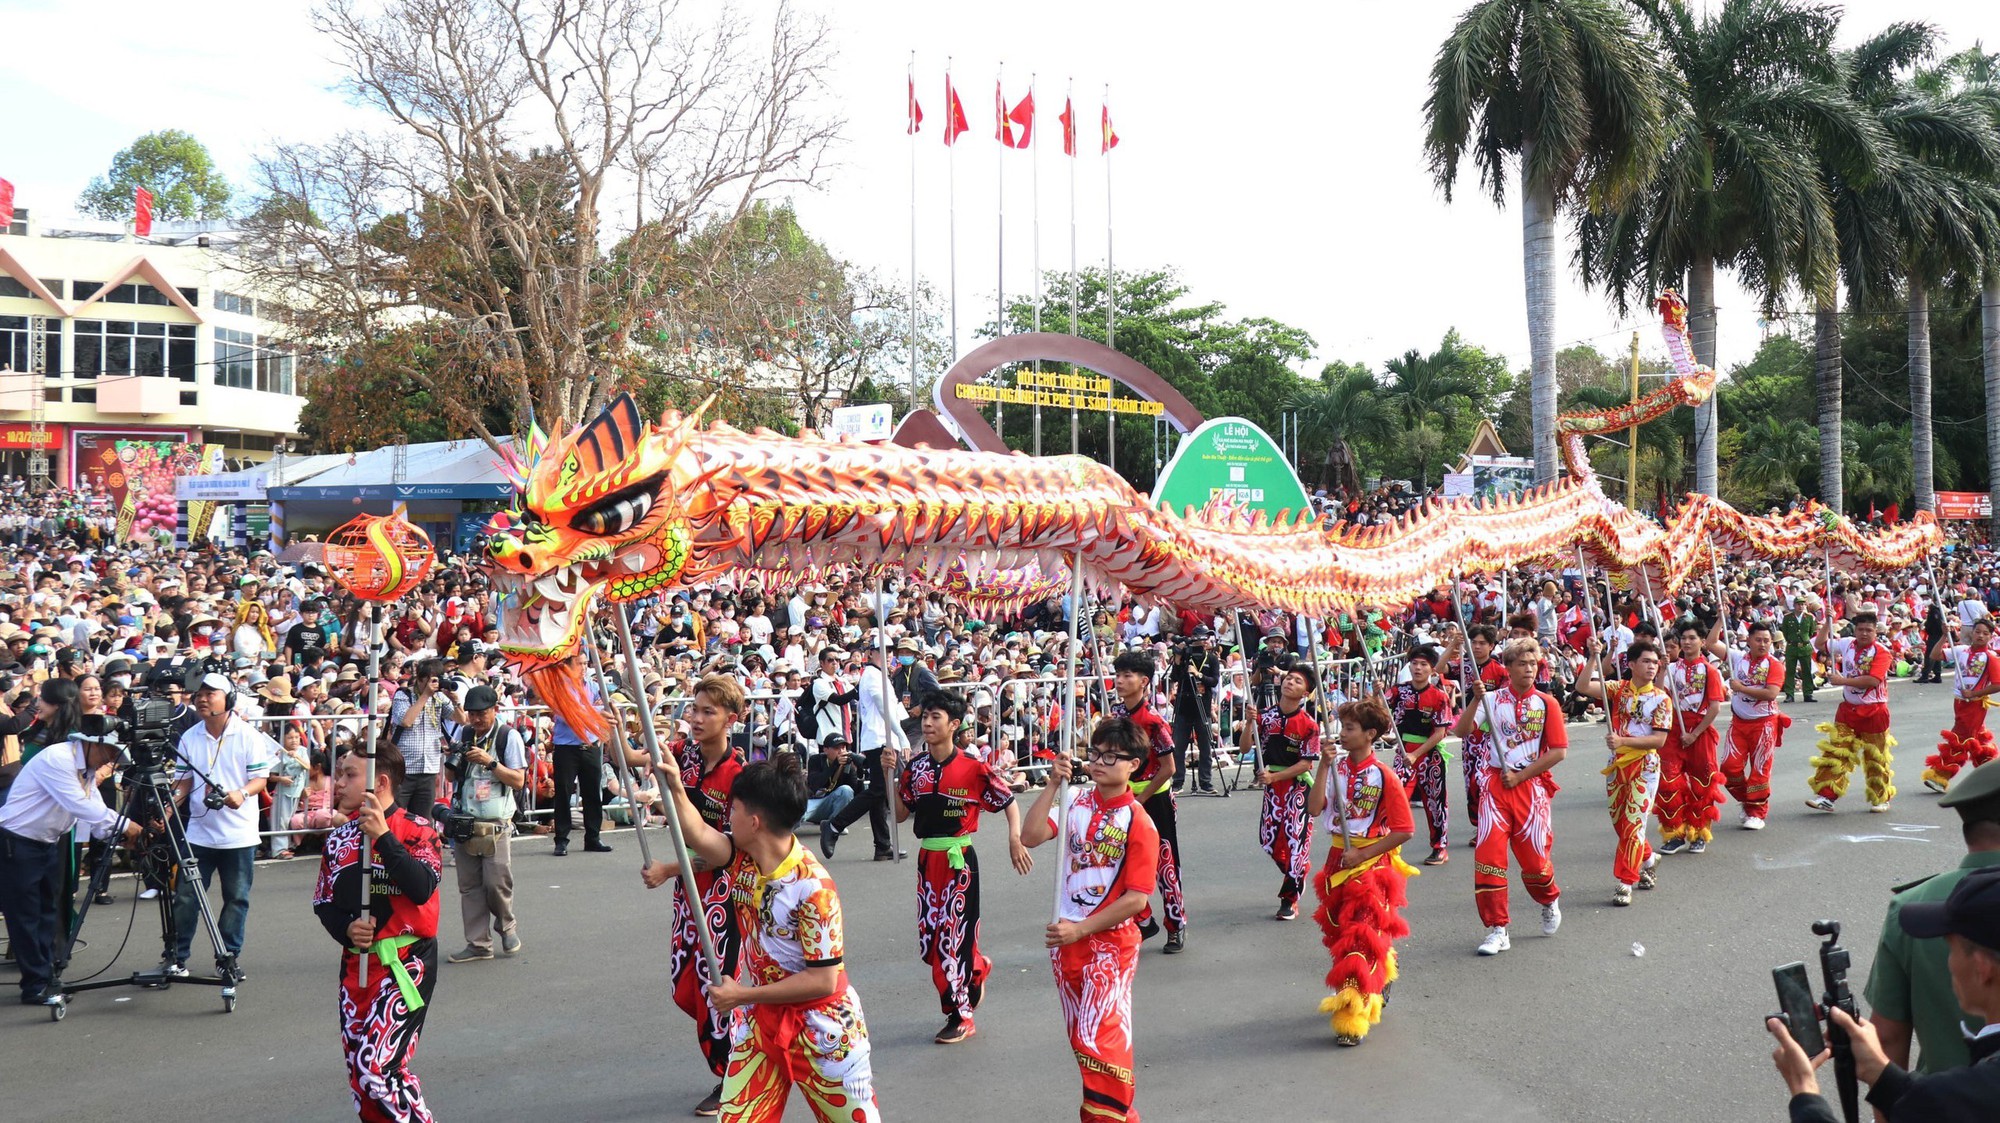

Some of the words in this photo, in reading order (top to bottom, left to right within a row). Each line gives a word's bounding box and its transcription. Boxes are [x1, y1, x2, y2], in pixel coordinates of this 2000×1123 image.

[1017, 367, 1034, 389] HỘI
[1036, 371, 1056, 391] CHỢ
[1000, 385, 1035, 405] NGÀNH
[1037, 388, 1051, 406] CÀ
[1074, 391, 1085, 409] VÀ
[1224, 424, 1234, 436] LỄ
[1234, 425, 1249, 438] HỘI
